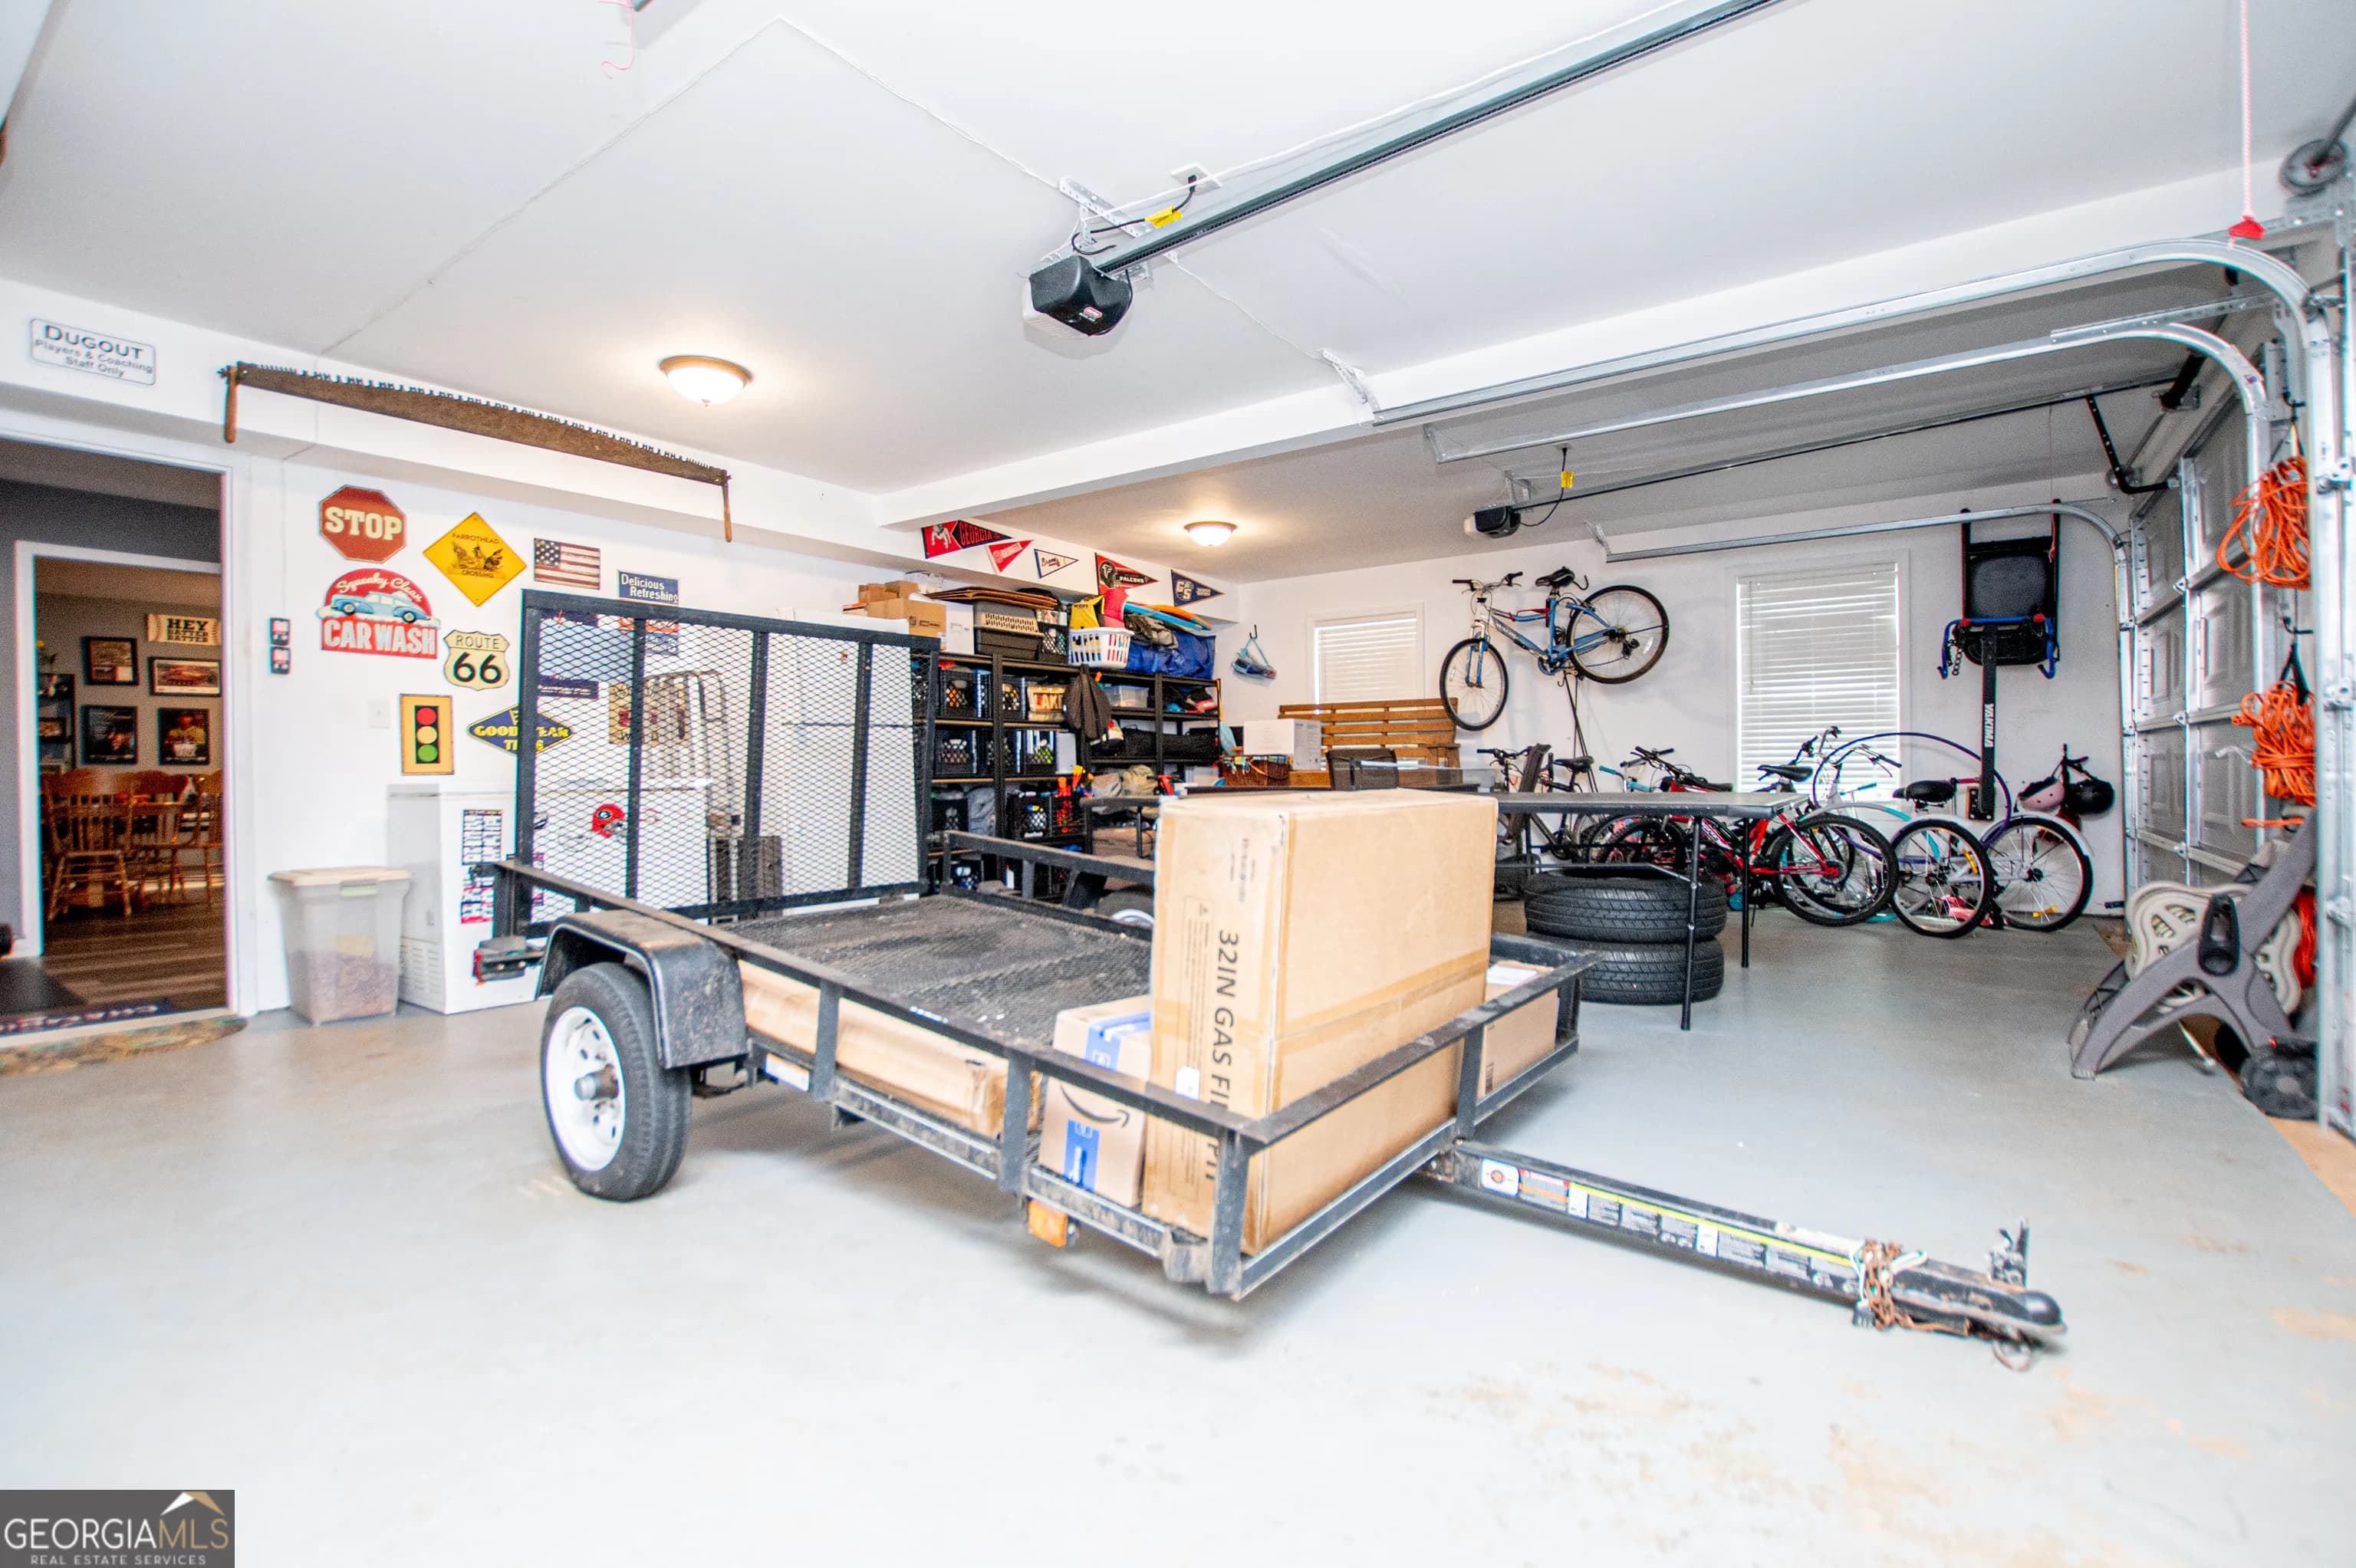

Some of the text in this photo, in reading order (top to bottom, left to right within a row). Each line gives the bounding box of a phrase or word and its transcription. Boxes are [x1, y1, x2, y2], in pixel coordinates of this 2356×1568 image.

[44, 324, 143, 360] DUGOUT
[35, 338, 81, 357] Players
[97, 353, 153, 374] Coaching
[66, 356, 124, 378] Staff Only
[325, 506, 403, 541] STOP
[958, 521, 992, 547] GEORGIA
[462, 568, 495, 579] CROSSING
[621, 574, 664, 590] Delicious
[1119, 575, 1145, 583] FALCONS
[336, 572, 423, 603] Squeaky Clean
[630, 586, 679, 603] Refreshing
[166, 618, 209, 631] HEY
[324, 620, 436, 655] CAR WASH
[456, 634, 500, 649] ROUTE
[452, 652, 502, 685] 66
[473, 725, 569, 738] GOODEAR
[1984, 703, 1994, 748] YAKIMA
[503, 739, 545, 751] TIS
[1216, 929, 1239, 998] 32IN
[1212, 1007, 1235, 1067] GAS
